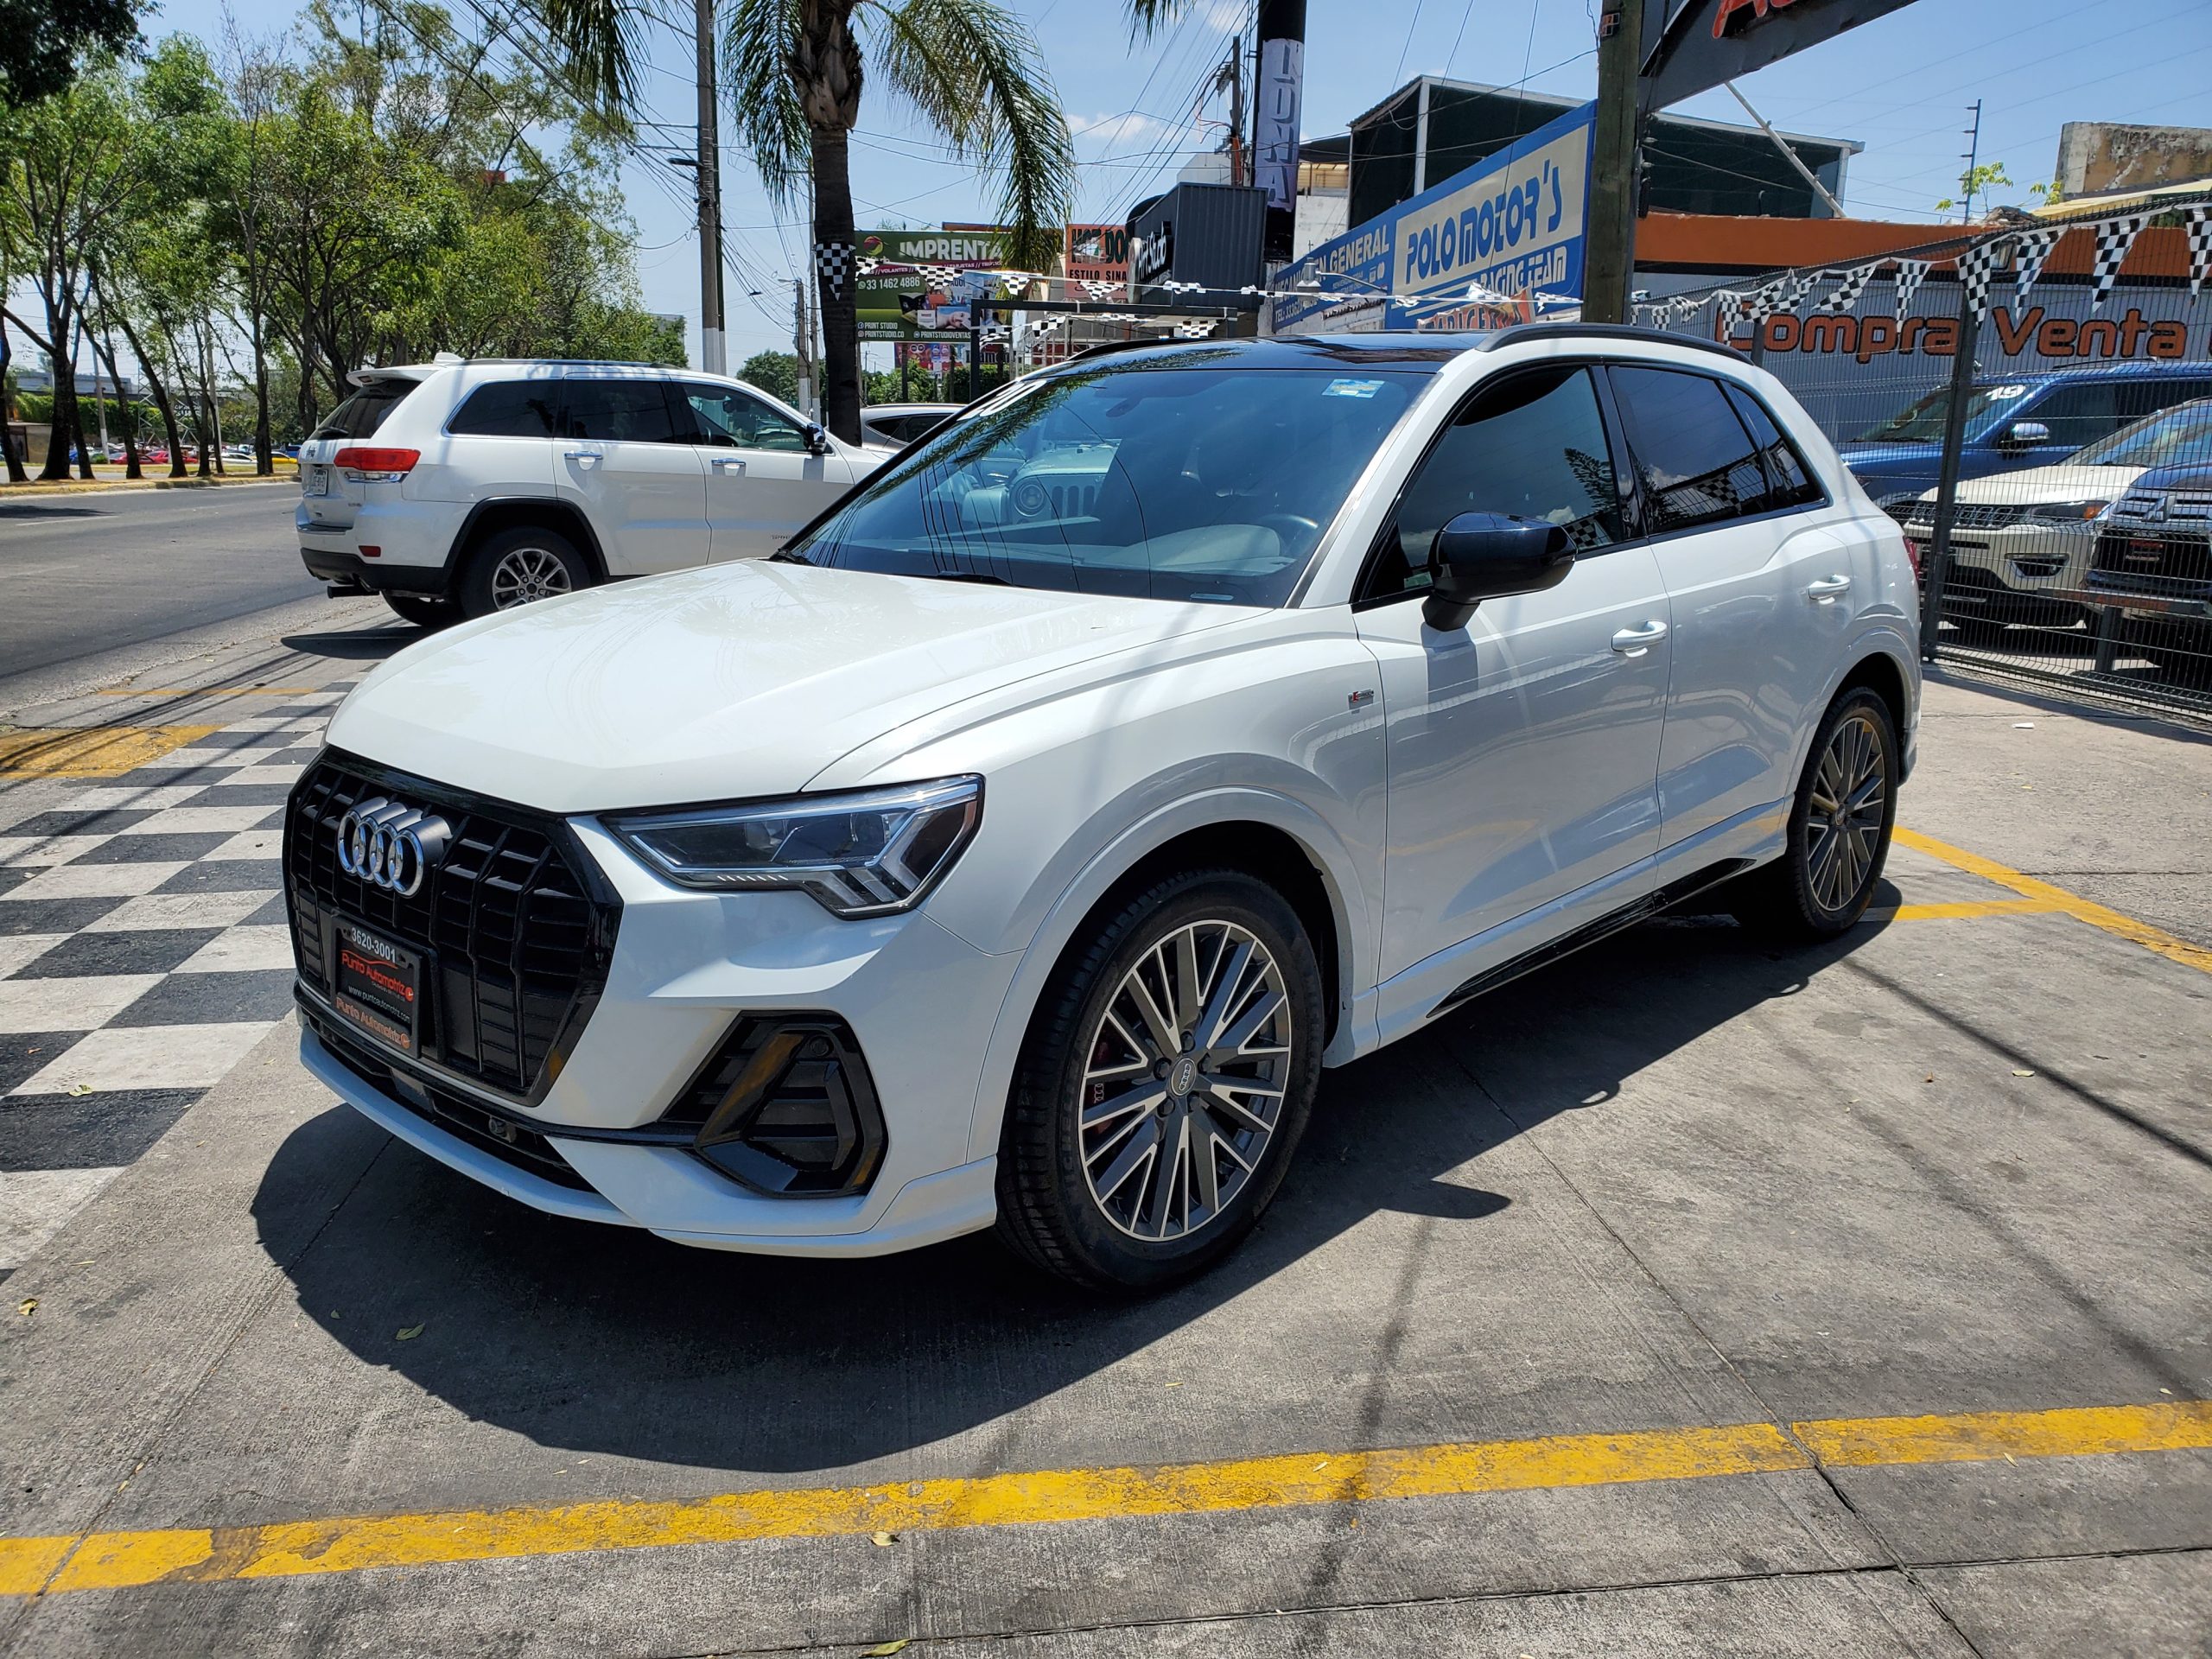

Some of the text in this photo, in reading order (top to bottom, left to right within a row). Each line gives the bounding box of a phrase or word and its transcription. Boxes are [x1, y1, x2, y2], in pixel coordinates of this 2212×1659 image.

[899, 238, 1003, 260] IMPRENTA
[1329, 224, 1389, 273] GENERAL
[867, 276, 920, 289] 33 1462 4886
[1070, 270, 1100, 280] ESTILO
[880, 321, 899, 330] STUDIO
[1991, 306, 2188, 359] Venta
[351, 927, 396, 963] 3620-3001
